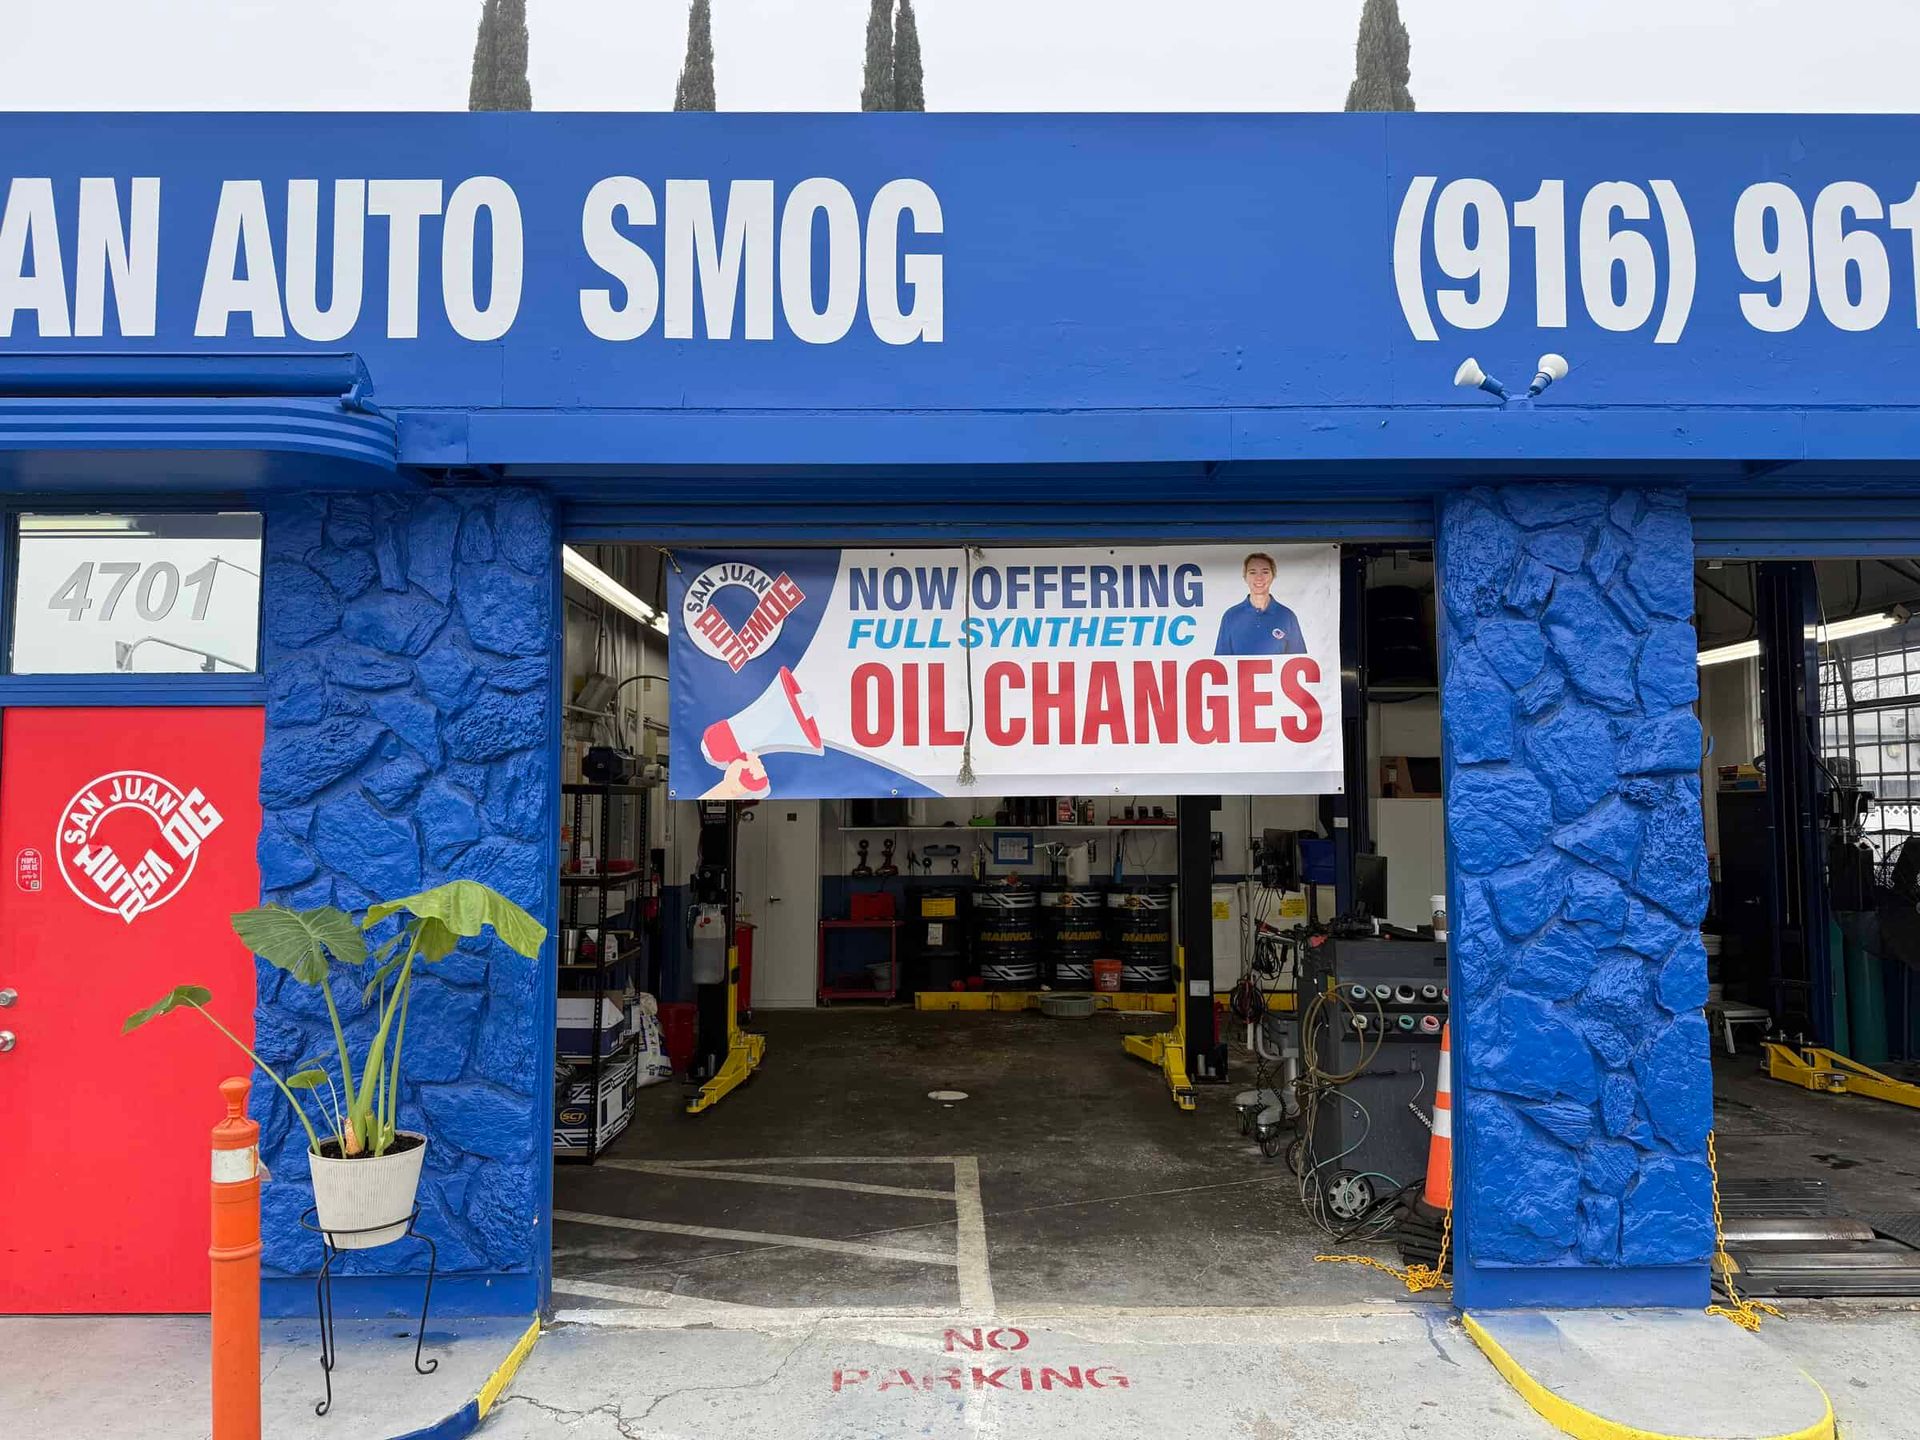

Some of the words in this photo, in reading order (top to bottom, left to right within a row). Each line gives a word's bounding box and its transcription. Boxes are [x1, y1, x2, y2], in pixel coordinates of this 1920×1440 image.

[194, 175, 524, 341] AUTO
[579, 175, 944, 345] SMOG
[1393, 176, 1697, 344] (916)
[48, 561, 219, 622] 4701
[686, 575, 717, 613] SAN
[719, 564, 771, 594] JUAN
[849, 566, 958, 611] NOW
[972, 563, 1204, 612] OFFERING
[693, 603, 748, 673] AUTO
[737, 571, 806, 654] SMOG
[847, 618, 951, 650] FULL
[958, 615, 1197, 650] SYNTHETIC
[850, 662, 965, 747] OIL
[984, 657, 1323, 747] CHANGES
[64, 790, 105, 845] SAN
[109, 778, 177, 817] JUAN
[562, 1112, 585, 1121] SCT
[943, 1327, 1030, 1352] NO
[831, 1365, 1130, 1392] PARKING
